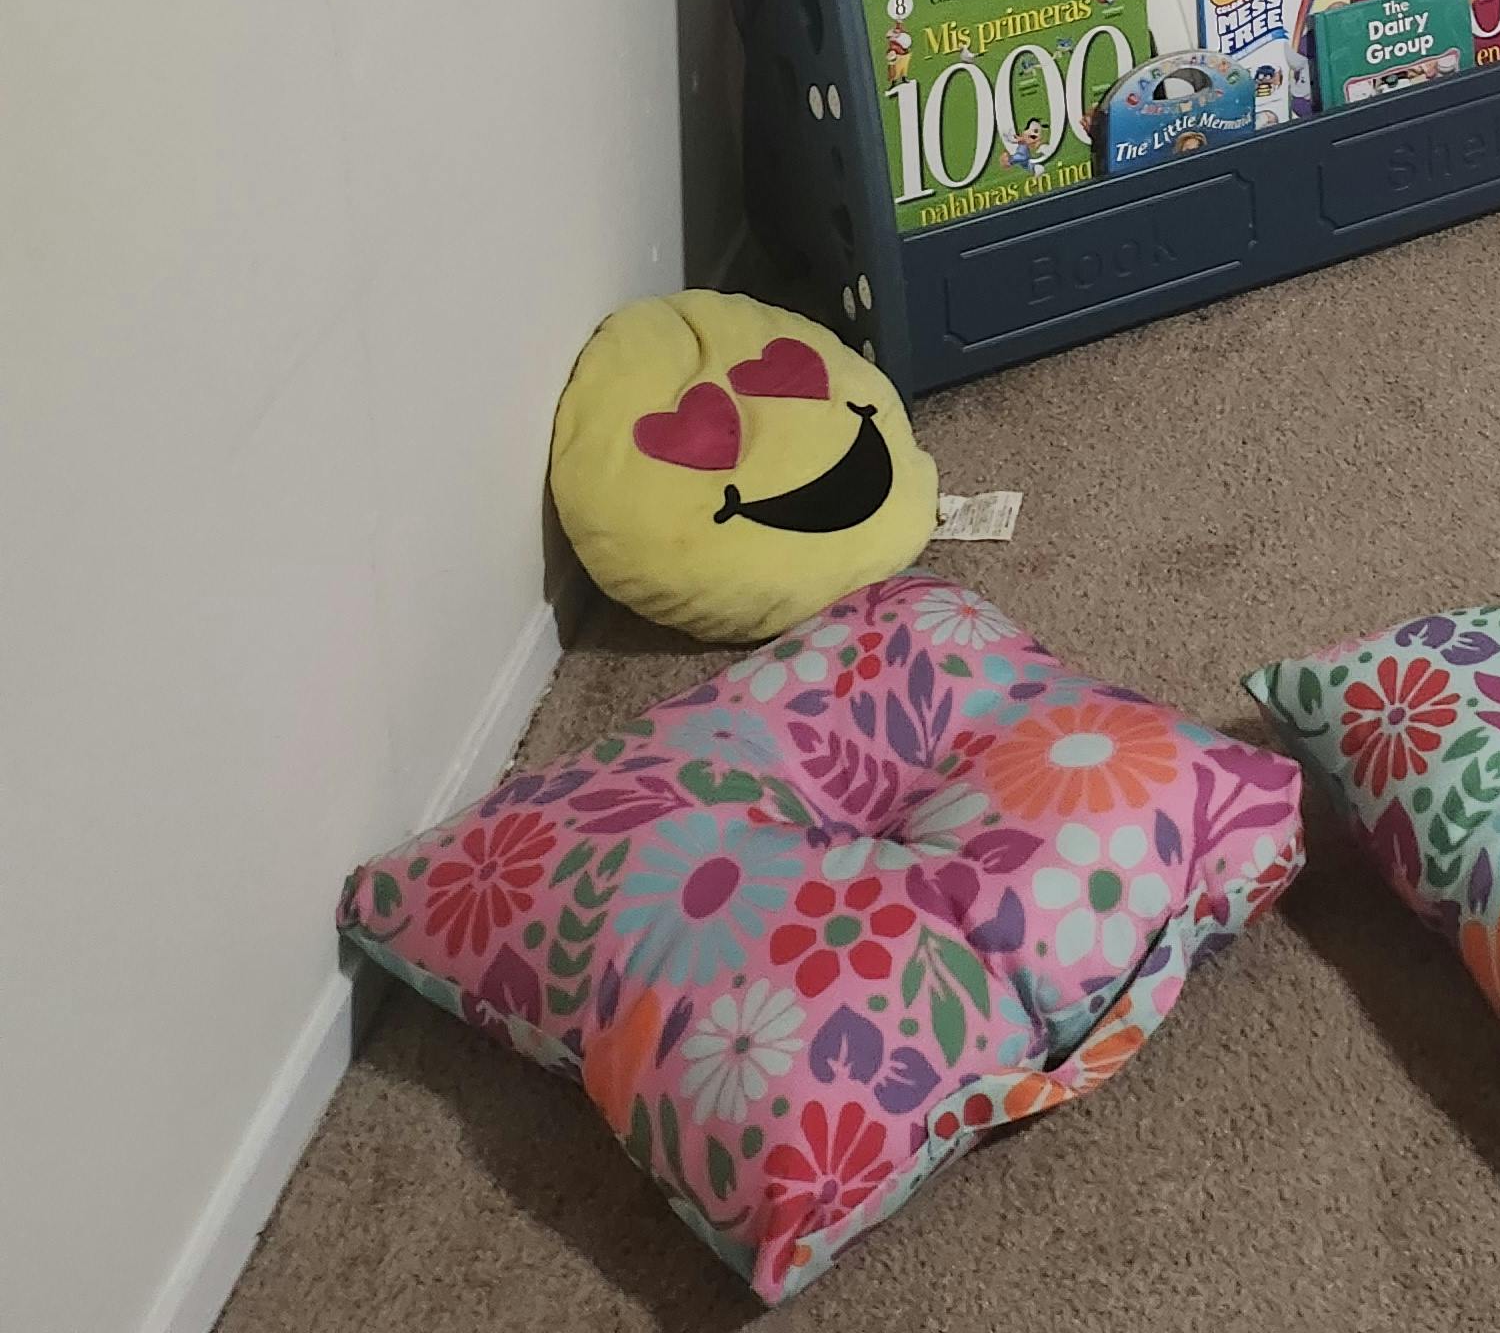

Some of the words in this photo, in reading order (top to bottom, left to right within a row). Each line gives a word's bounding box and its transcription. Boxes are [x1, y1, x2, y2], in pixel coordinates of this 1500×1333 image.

[1368, 11, 1429, 41] Dairy
[1382, 0, 1410, 16] The
[922, 20, 971, 60] Mis
[1220, 8, 1284, 54] FREE
[1366, 35, 1434, 64] Group
[1477, 44, 1500, 65] en
[884, 25, 1136, 205] 1000
[1116, 143, 1148, 162] The
[1153, 115, 1196, 150] Little
[920, 185, 1019, 226] palabras
[1024, 175, 1052, 197] en
